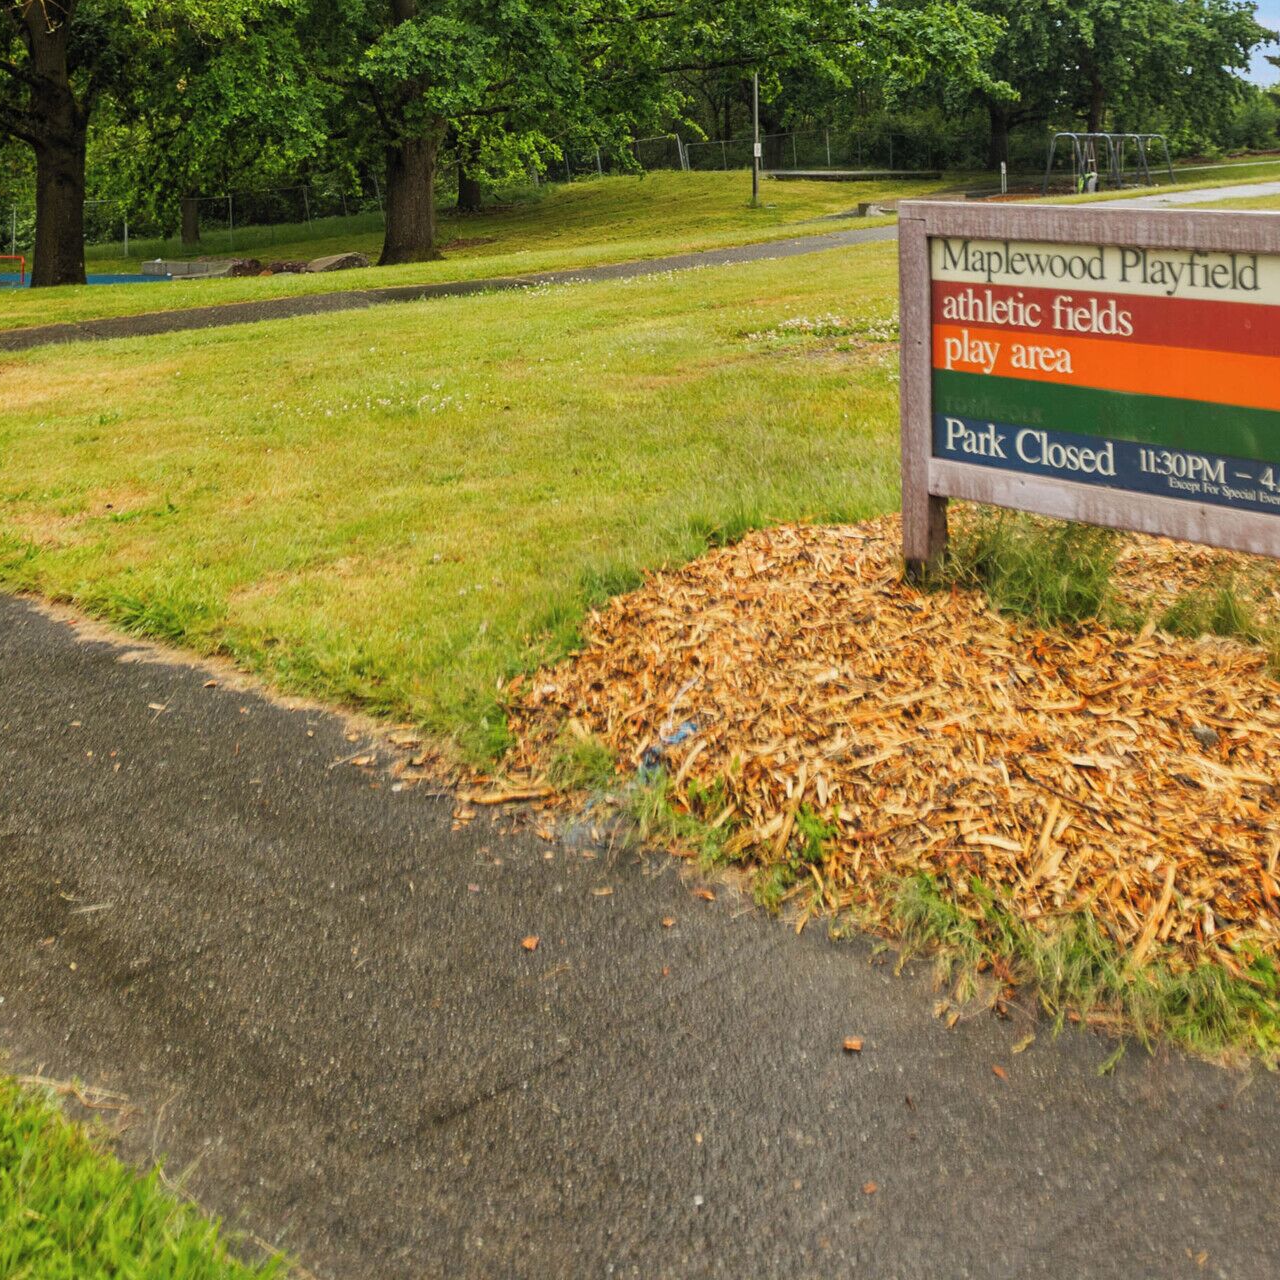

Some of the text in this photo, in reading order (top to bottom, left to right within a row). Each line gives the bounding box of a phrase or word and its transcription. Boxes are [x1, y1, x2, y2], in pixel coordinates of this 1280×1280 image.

[941, 238, 1261, 296] Maplewood Playfield
[942, 288, 1134, 337] athletic fields
[944, 329, 1074, 375] play area
[945, 417, 1008, 459] Park
[1015, 428, 1118, 477] Closed
[1139, 448, 1227, 485] 11:30PM
[1169, 476, 1201, 494] Except
[1203, 481, 1219, 496] For
[1222, 485, 1257, 502] Special
